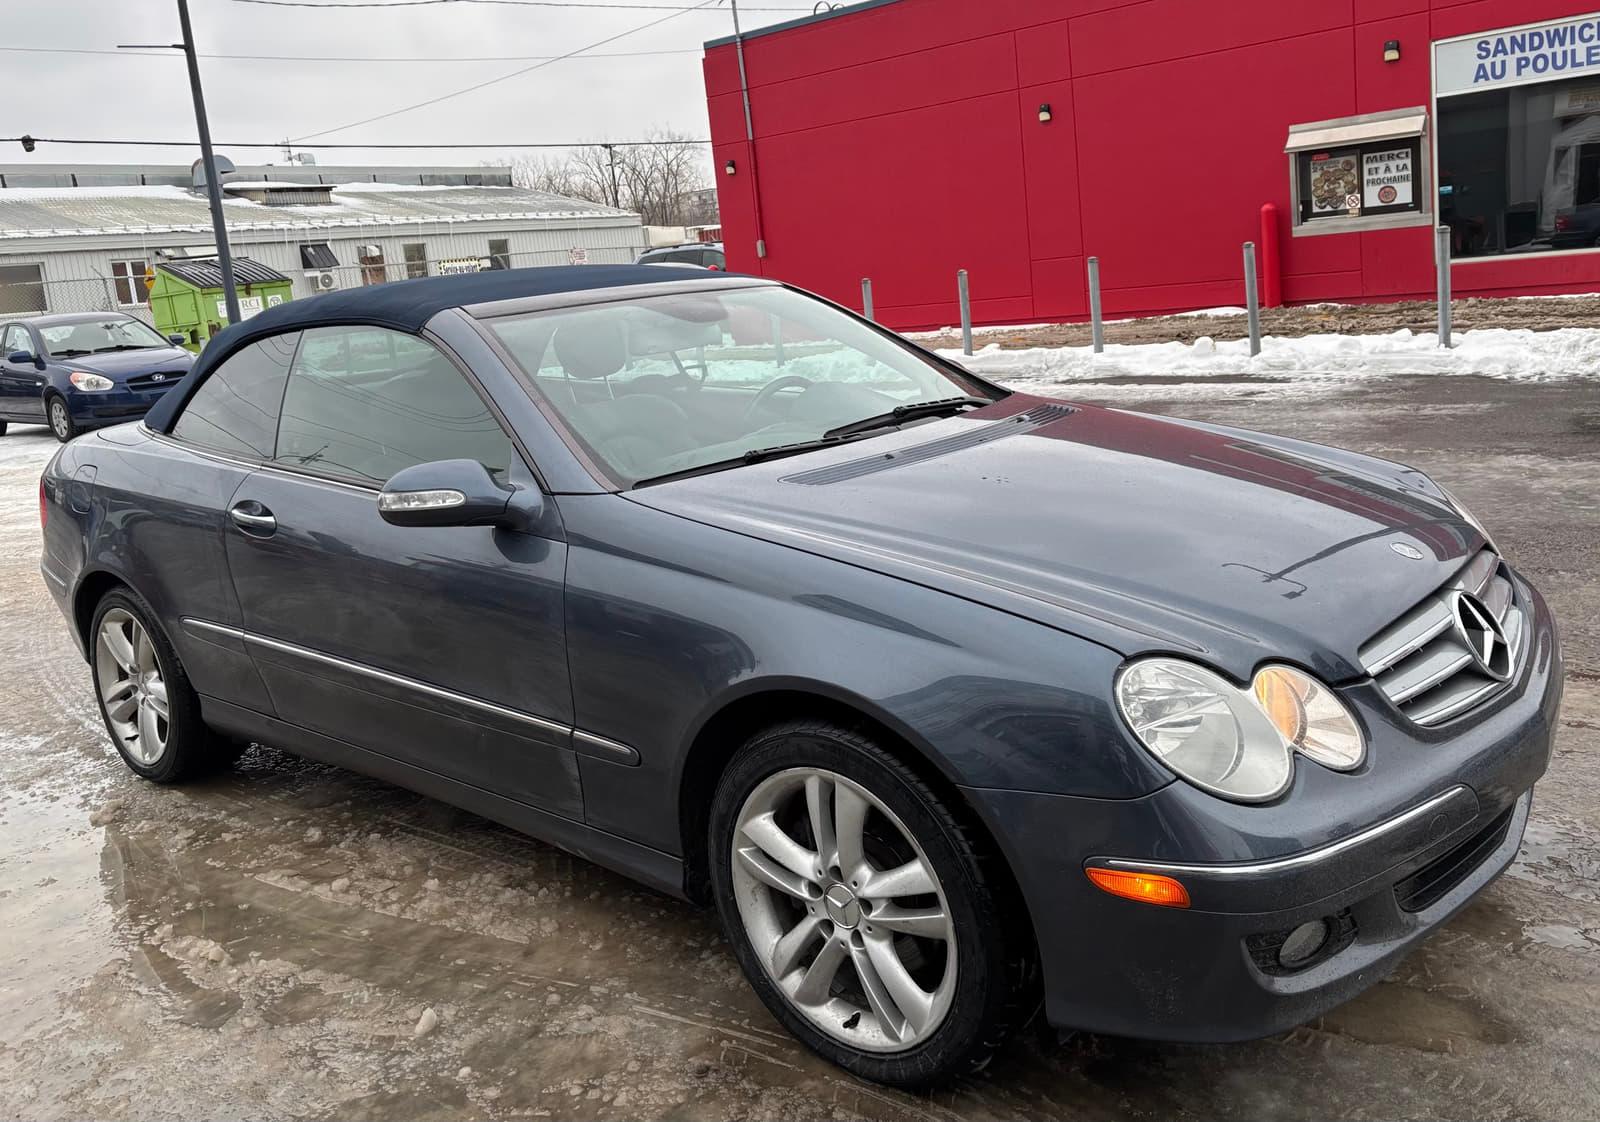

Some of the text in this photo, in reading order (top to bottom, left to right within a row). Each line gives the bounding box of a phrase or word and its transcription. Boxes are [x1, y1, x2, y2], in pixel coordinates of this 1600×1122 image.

[1476, 22, 1600, 60] SANDWIC
[1473, 59, 1506, 83] AU
[1365, 151, 1410, 164] MERCI
[1368, 163, 1409, 176] ET À LA
[1366, 173, 1411, 187] PROCHAINE
[241, 298, 260, 309] RCI
